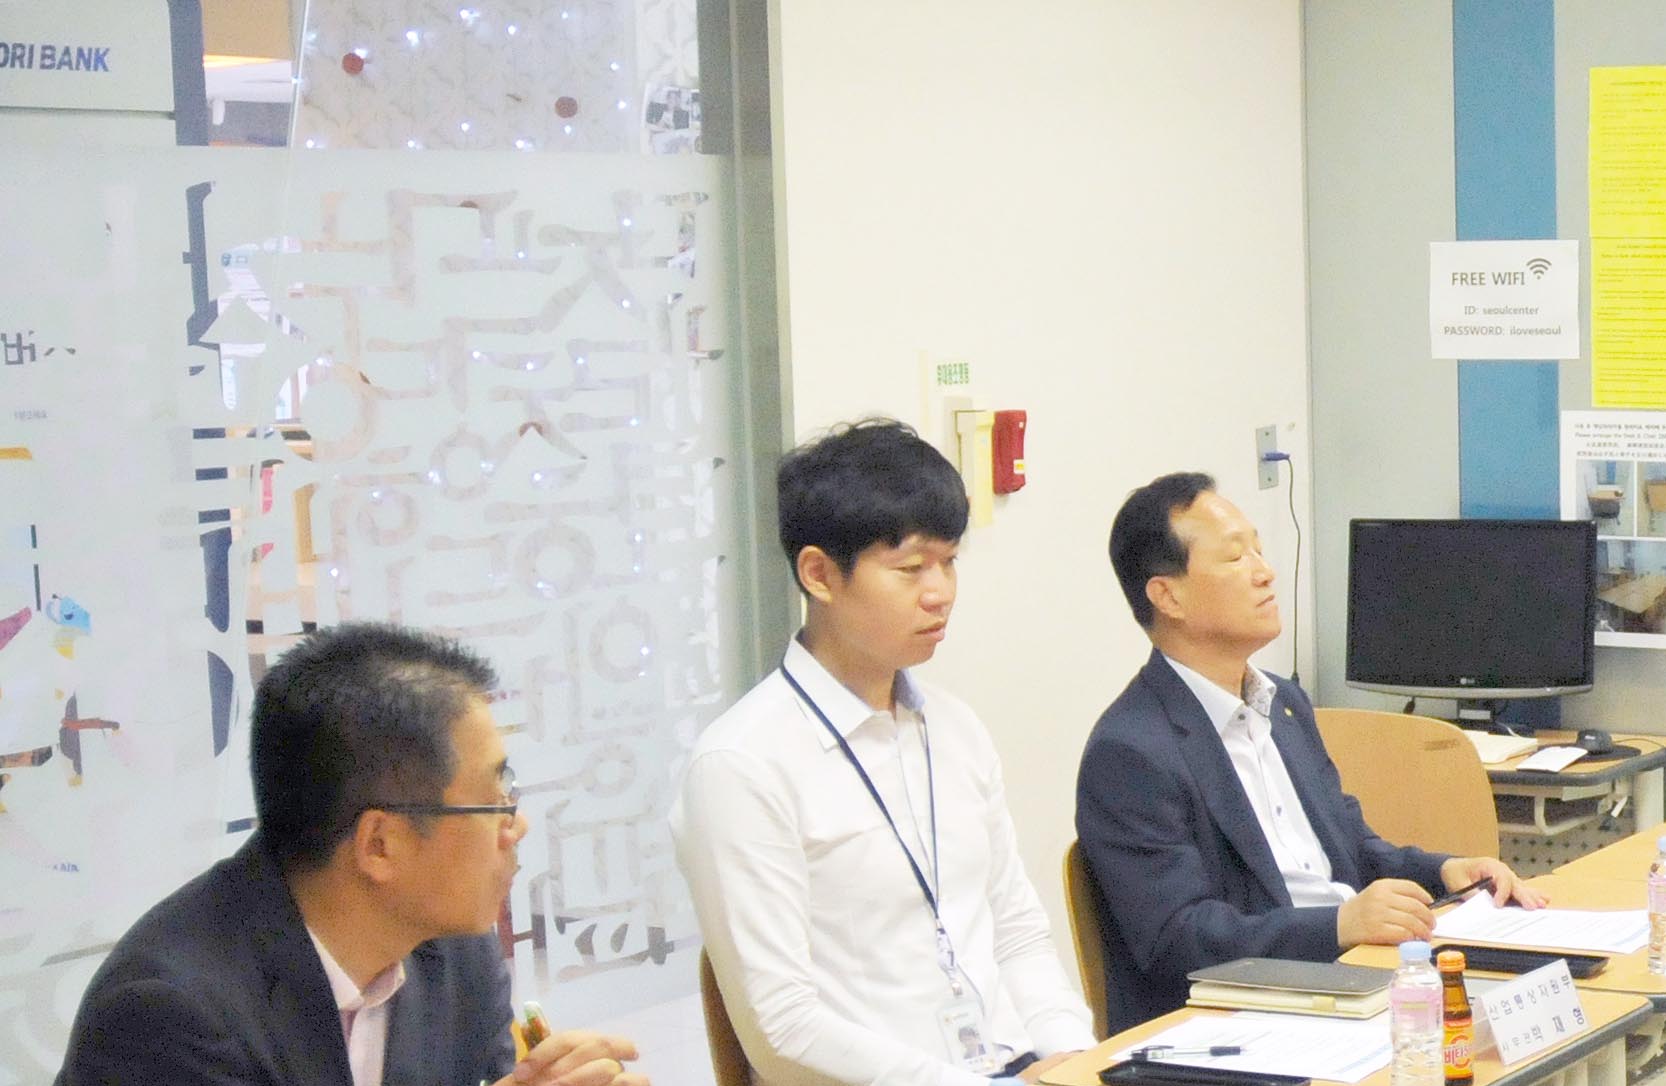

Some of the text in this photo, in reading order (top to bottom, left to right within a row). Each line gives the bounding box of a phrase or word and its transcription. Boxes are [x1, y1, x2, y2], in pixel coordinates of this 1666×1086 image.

[39, 45, 111, 72] BANK
[1451, 271, 1526, 287] FREE WIFI
[1483, 305, 1539, 316] seoulcenter
[1444, 325, 1561, 336] PASSWORD: iloveseoul
[1488, 974, 1571, 1021] 산업통상자원부
